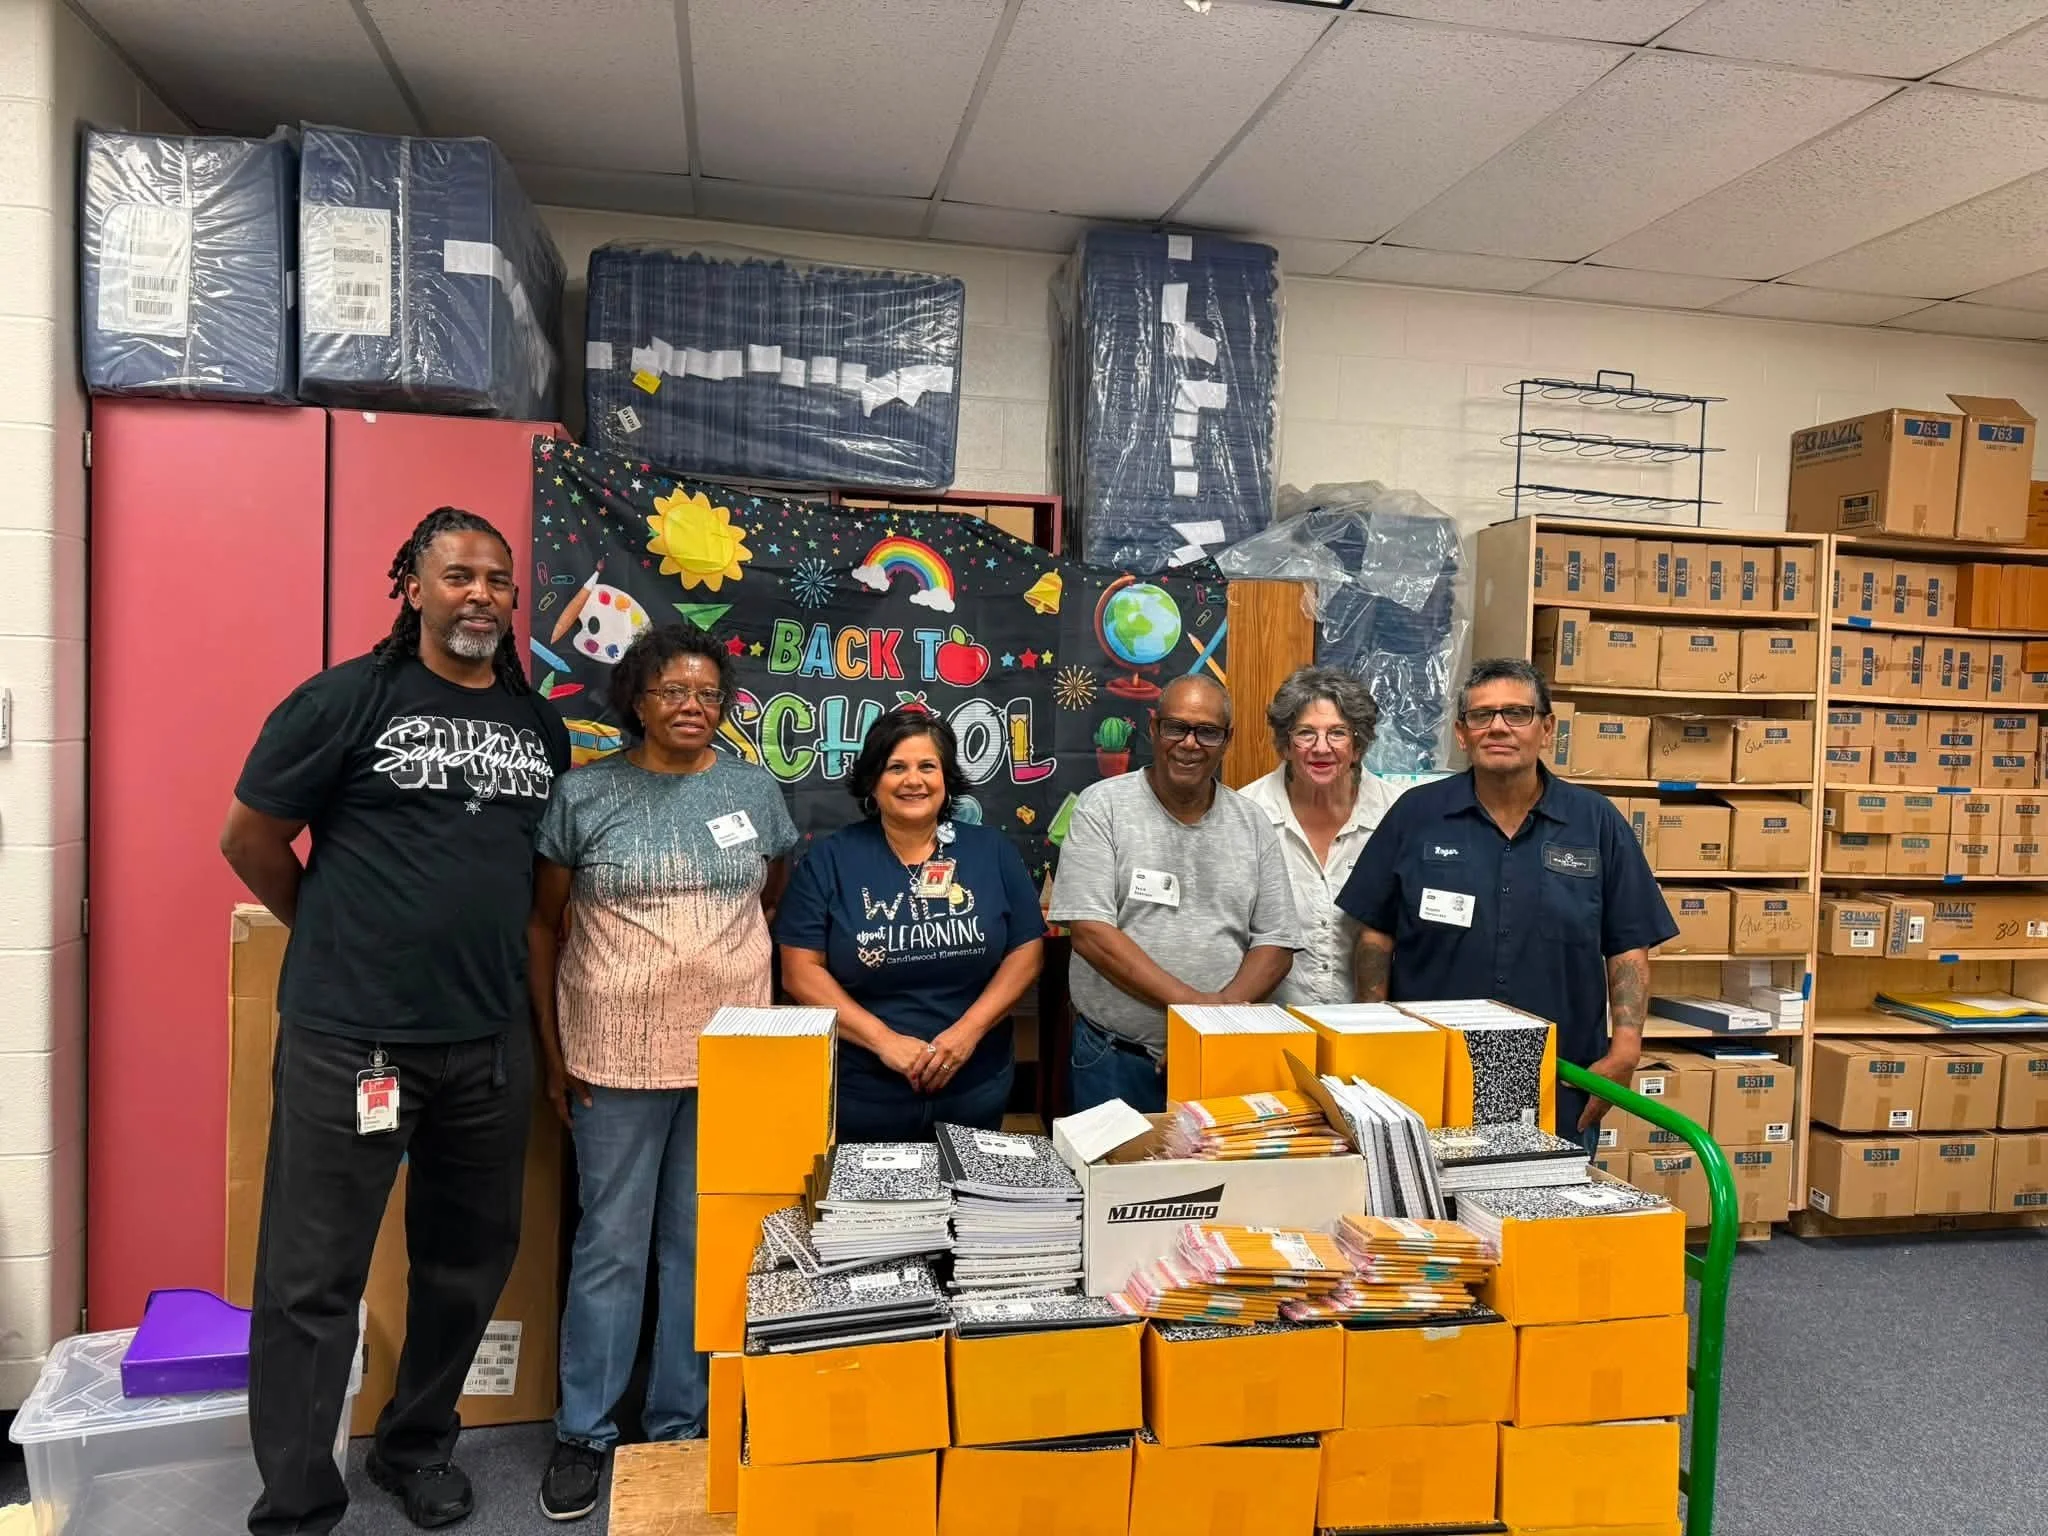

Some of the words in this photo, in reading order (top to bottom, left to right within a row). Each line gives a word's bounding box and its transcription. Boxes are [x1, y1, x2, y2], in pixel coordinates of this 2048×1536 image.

[1916, 422, 1939, 435] 763
[1991, 426, 2013, 441] 763
[1605, 562, 1616, 585] 763
[1677, 567, 1686, 586] 763
[1743, 571, 1753, 591] 763
[1784, 571, 1795, 592] 763
[1863, 582, 1873, 600] 763
[767, 618, 905, 682] BACK
[712, 688, 1057, 785] SCHOL
[856, 925, 887, 946] about
[888, 915, 986, 953] LEARNING
[886, 952, 937, 965] Candlewood
[939, 946, 987, 960] Elementary
[1876, 1061, 1897, 1073] 5511
[1954, 1062, 1976, 1073] 5511
[1744, 1076, 1767, 1088] 5511
[1742, 1152, 1764, 1163] 5511
[1871, 1149, 1892, 1160] 5511
[1947, 1144, 1968, 1156] 5511
[1661, 1158, 1685, 1170] 5511
[1107, 1205, 1139, 1221] MJ
[1139, 1203, 1219, 1220] Holding
